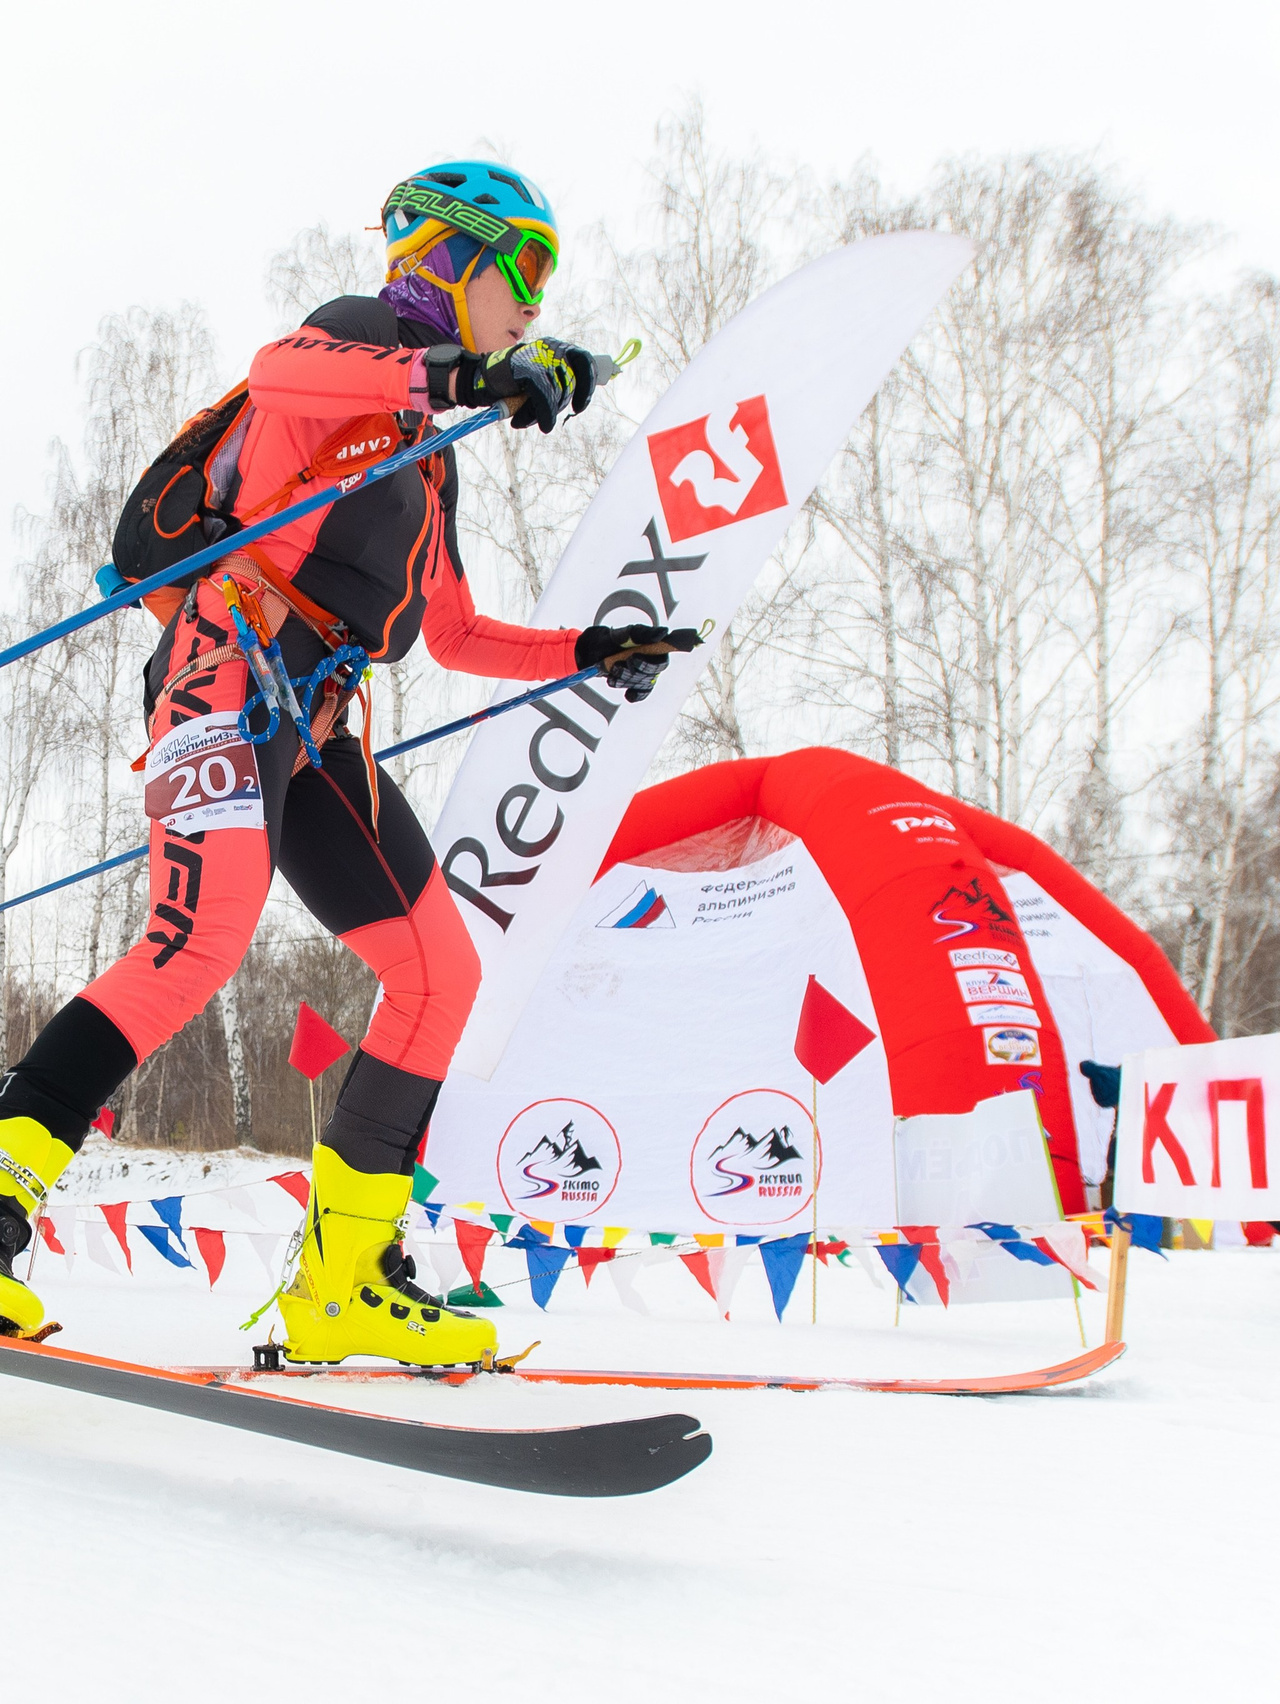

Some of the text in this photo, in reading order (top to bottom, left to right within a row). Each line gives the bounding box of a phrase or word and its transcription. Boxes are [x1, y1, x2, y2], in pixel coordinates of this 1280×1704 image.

[336, 435, 391, 460] CAMP
[335, 472, 363, 494] Rex
[168, 755, 256, 810] 20 2
[697, 881, 796, 912] альпинизма
[953, 950, 1004, 962] RedFox
[967, 985, 1029, 998] ВЕРШИН
[1141, 1077, 1269, 1190] КП
[562, 1179, 600, 1191] SKIMO
[758, 1173, 803, 1185] SKYRUN
[561, 1191, 599, 1202] RUSSIA
[758, 1185, 803, 1197] RUSSIA
